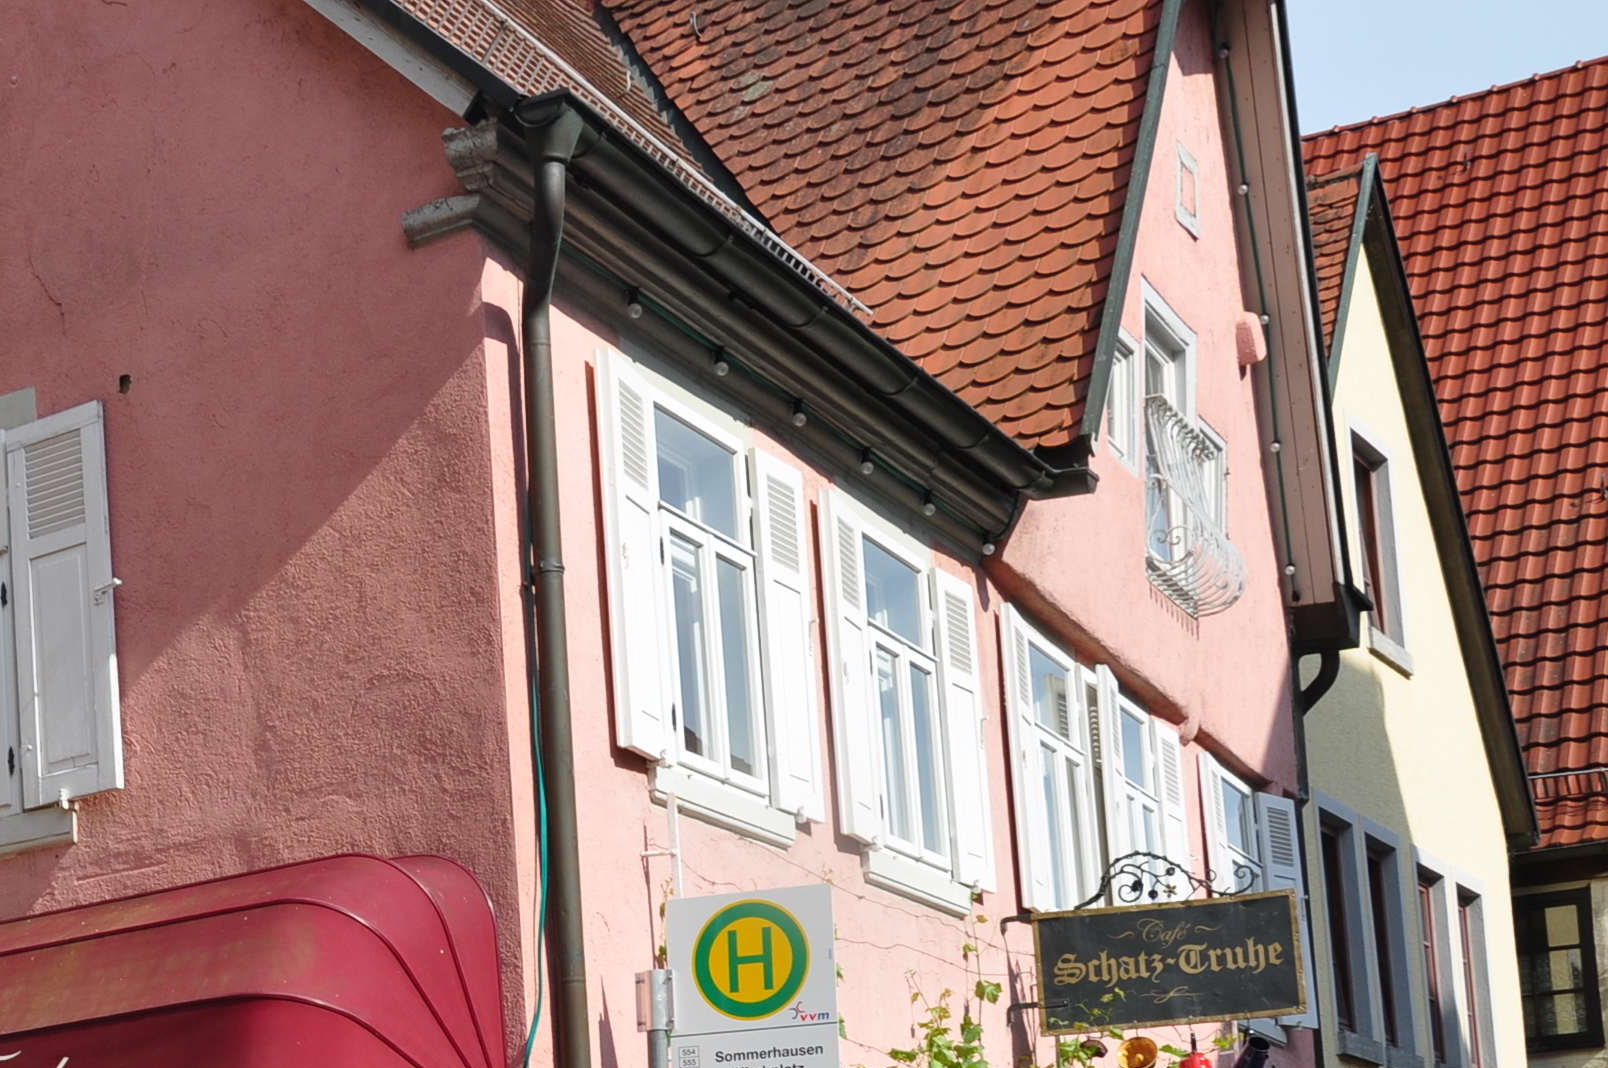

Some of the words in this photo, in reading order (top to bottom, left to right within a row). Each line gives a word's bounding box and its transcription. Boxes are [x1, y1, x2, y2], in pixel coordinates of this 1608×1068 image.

[1137, 917, 1192, 948] Café
[727, 926, 774, 993] H
[1053, 937, 1284, 988] Schatz-Truhe
[800, 1012, 830, 1022] vvm
[715, 1044, 824, 1063] Sommerhausen
